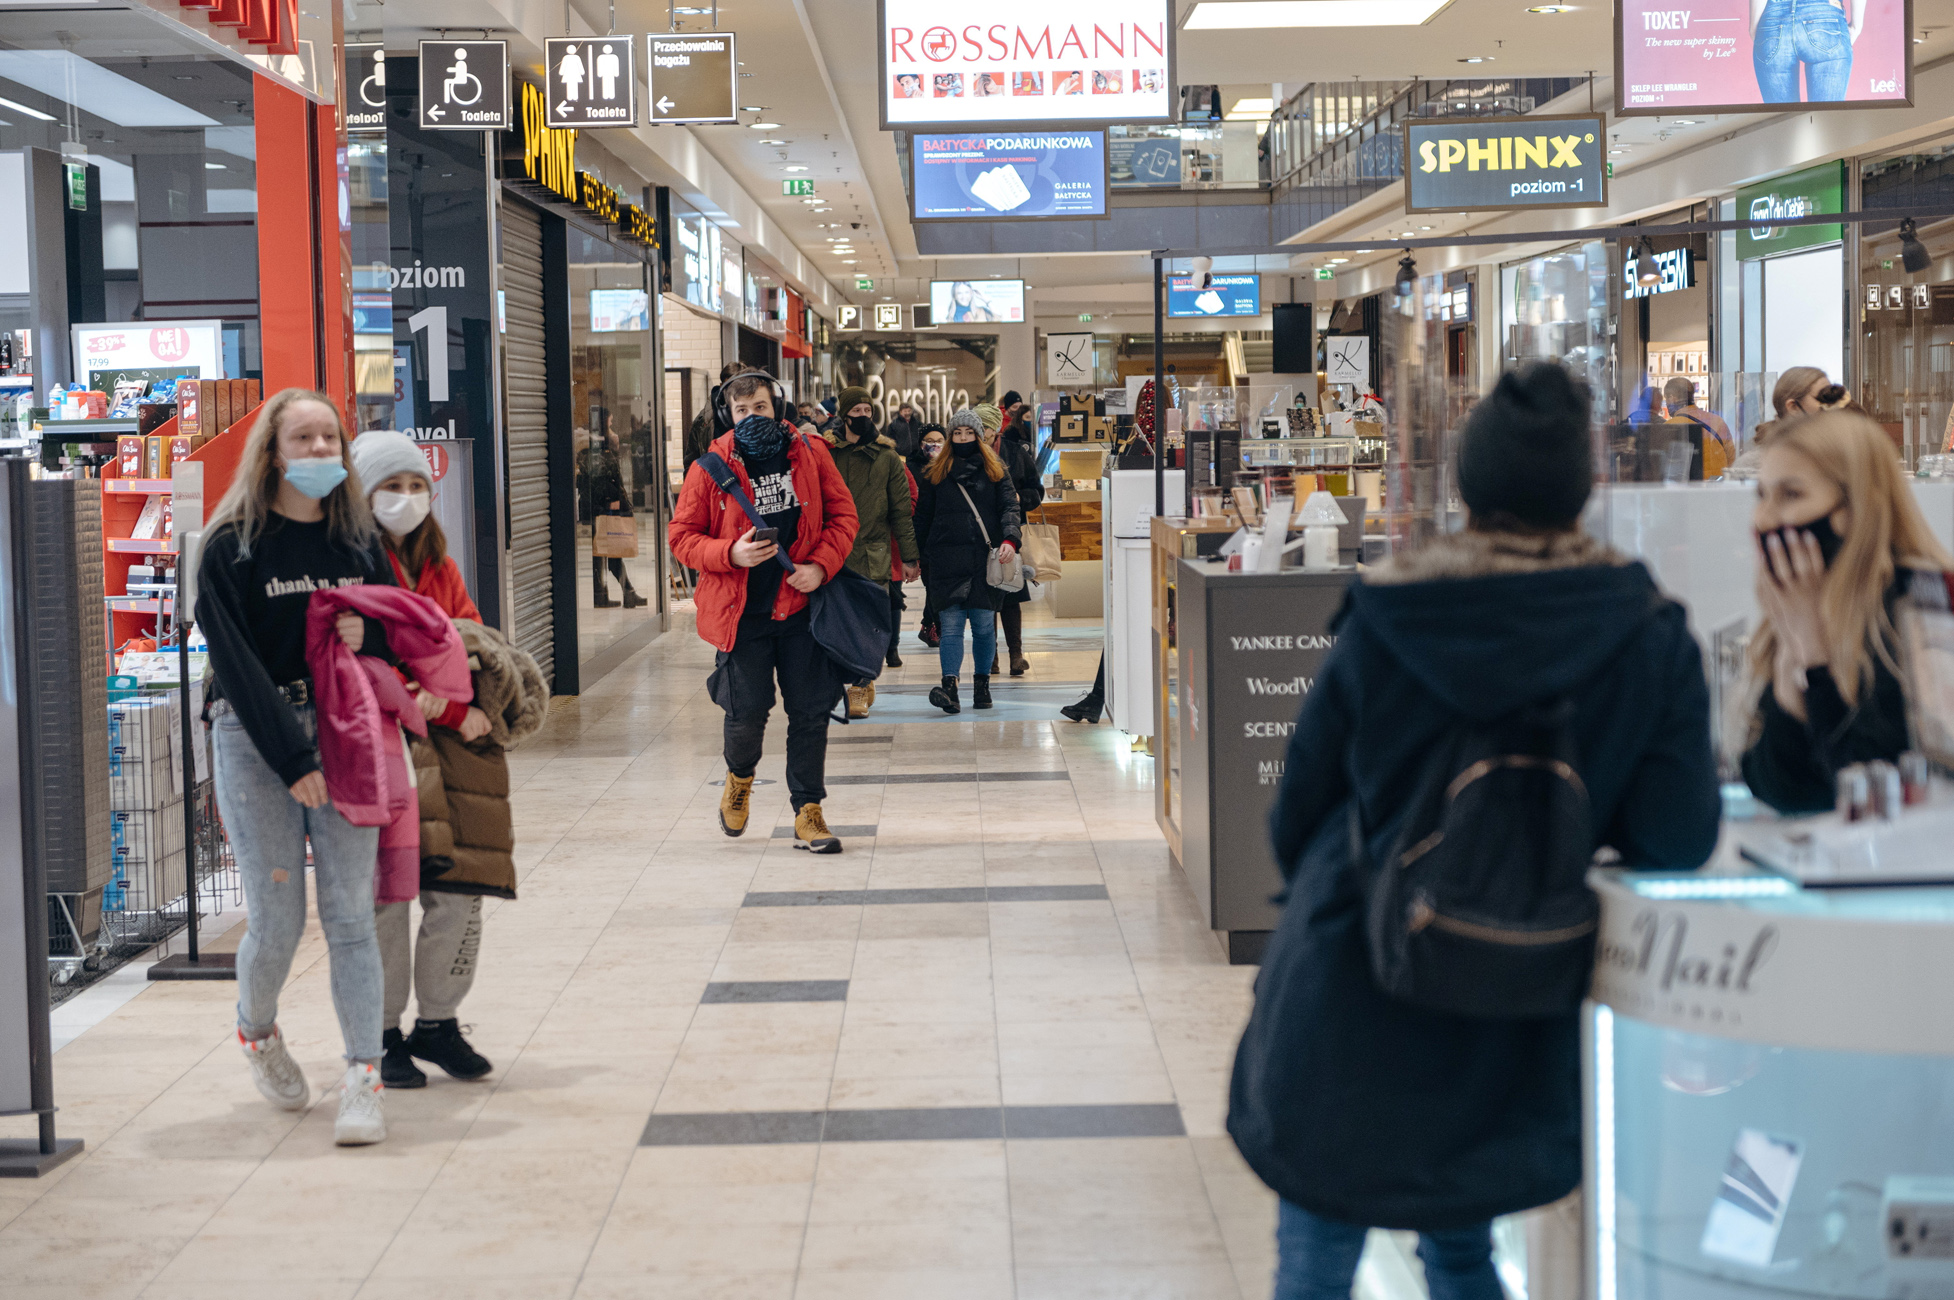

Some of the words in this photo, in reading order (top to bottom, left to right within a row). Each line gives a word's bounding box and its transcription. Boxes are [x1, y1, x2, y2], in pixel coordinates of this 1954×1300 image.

[1642, 10, 1691, 30] TOXEY
[654, 40, 725, 52] Przechowalnia
[891, 22, 1164, 63] ROSSMANN
[1645, 37, 1662, 47] The
[1664, 38, 1682, 47] new
[1684, 38, 1707, 48] super
[1708, 35, 1736, 47] skinny
[1703, 48, 1714, 60] by
[654, 54, 690, 68] bagażu
[1631, 85, 1651, 93] SKLEP
[1652, 84, 1663, 92] LEE
[1664, 82, 1698, 91] WRANGLER
[1870, 78, 1896, 93] Lee
[1631, 94, 1655, 103] POZIOM
[460, 110, 501, 122] Toaleta
[586, 106, 627, 118] Toaleta
[1054, 182, 1092, 190] GALERIA
[1510, 178, 1566, 198] poziom
[1569, 177, 1584, 192] -1
[372, 259, 465, 289] Poziom
[408, 306, 450, 402] 1
[88, 358, 110, 368] 17,99
[265, 574, 318, 598] thank
[1230, 635, 1294, 651] YANKEE
